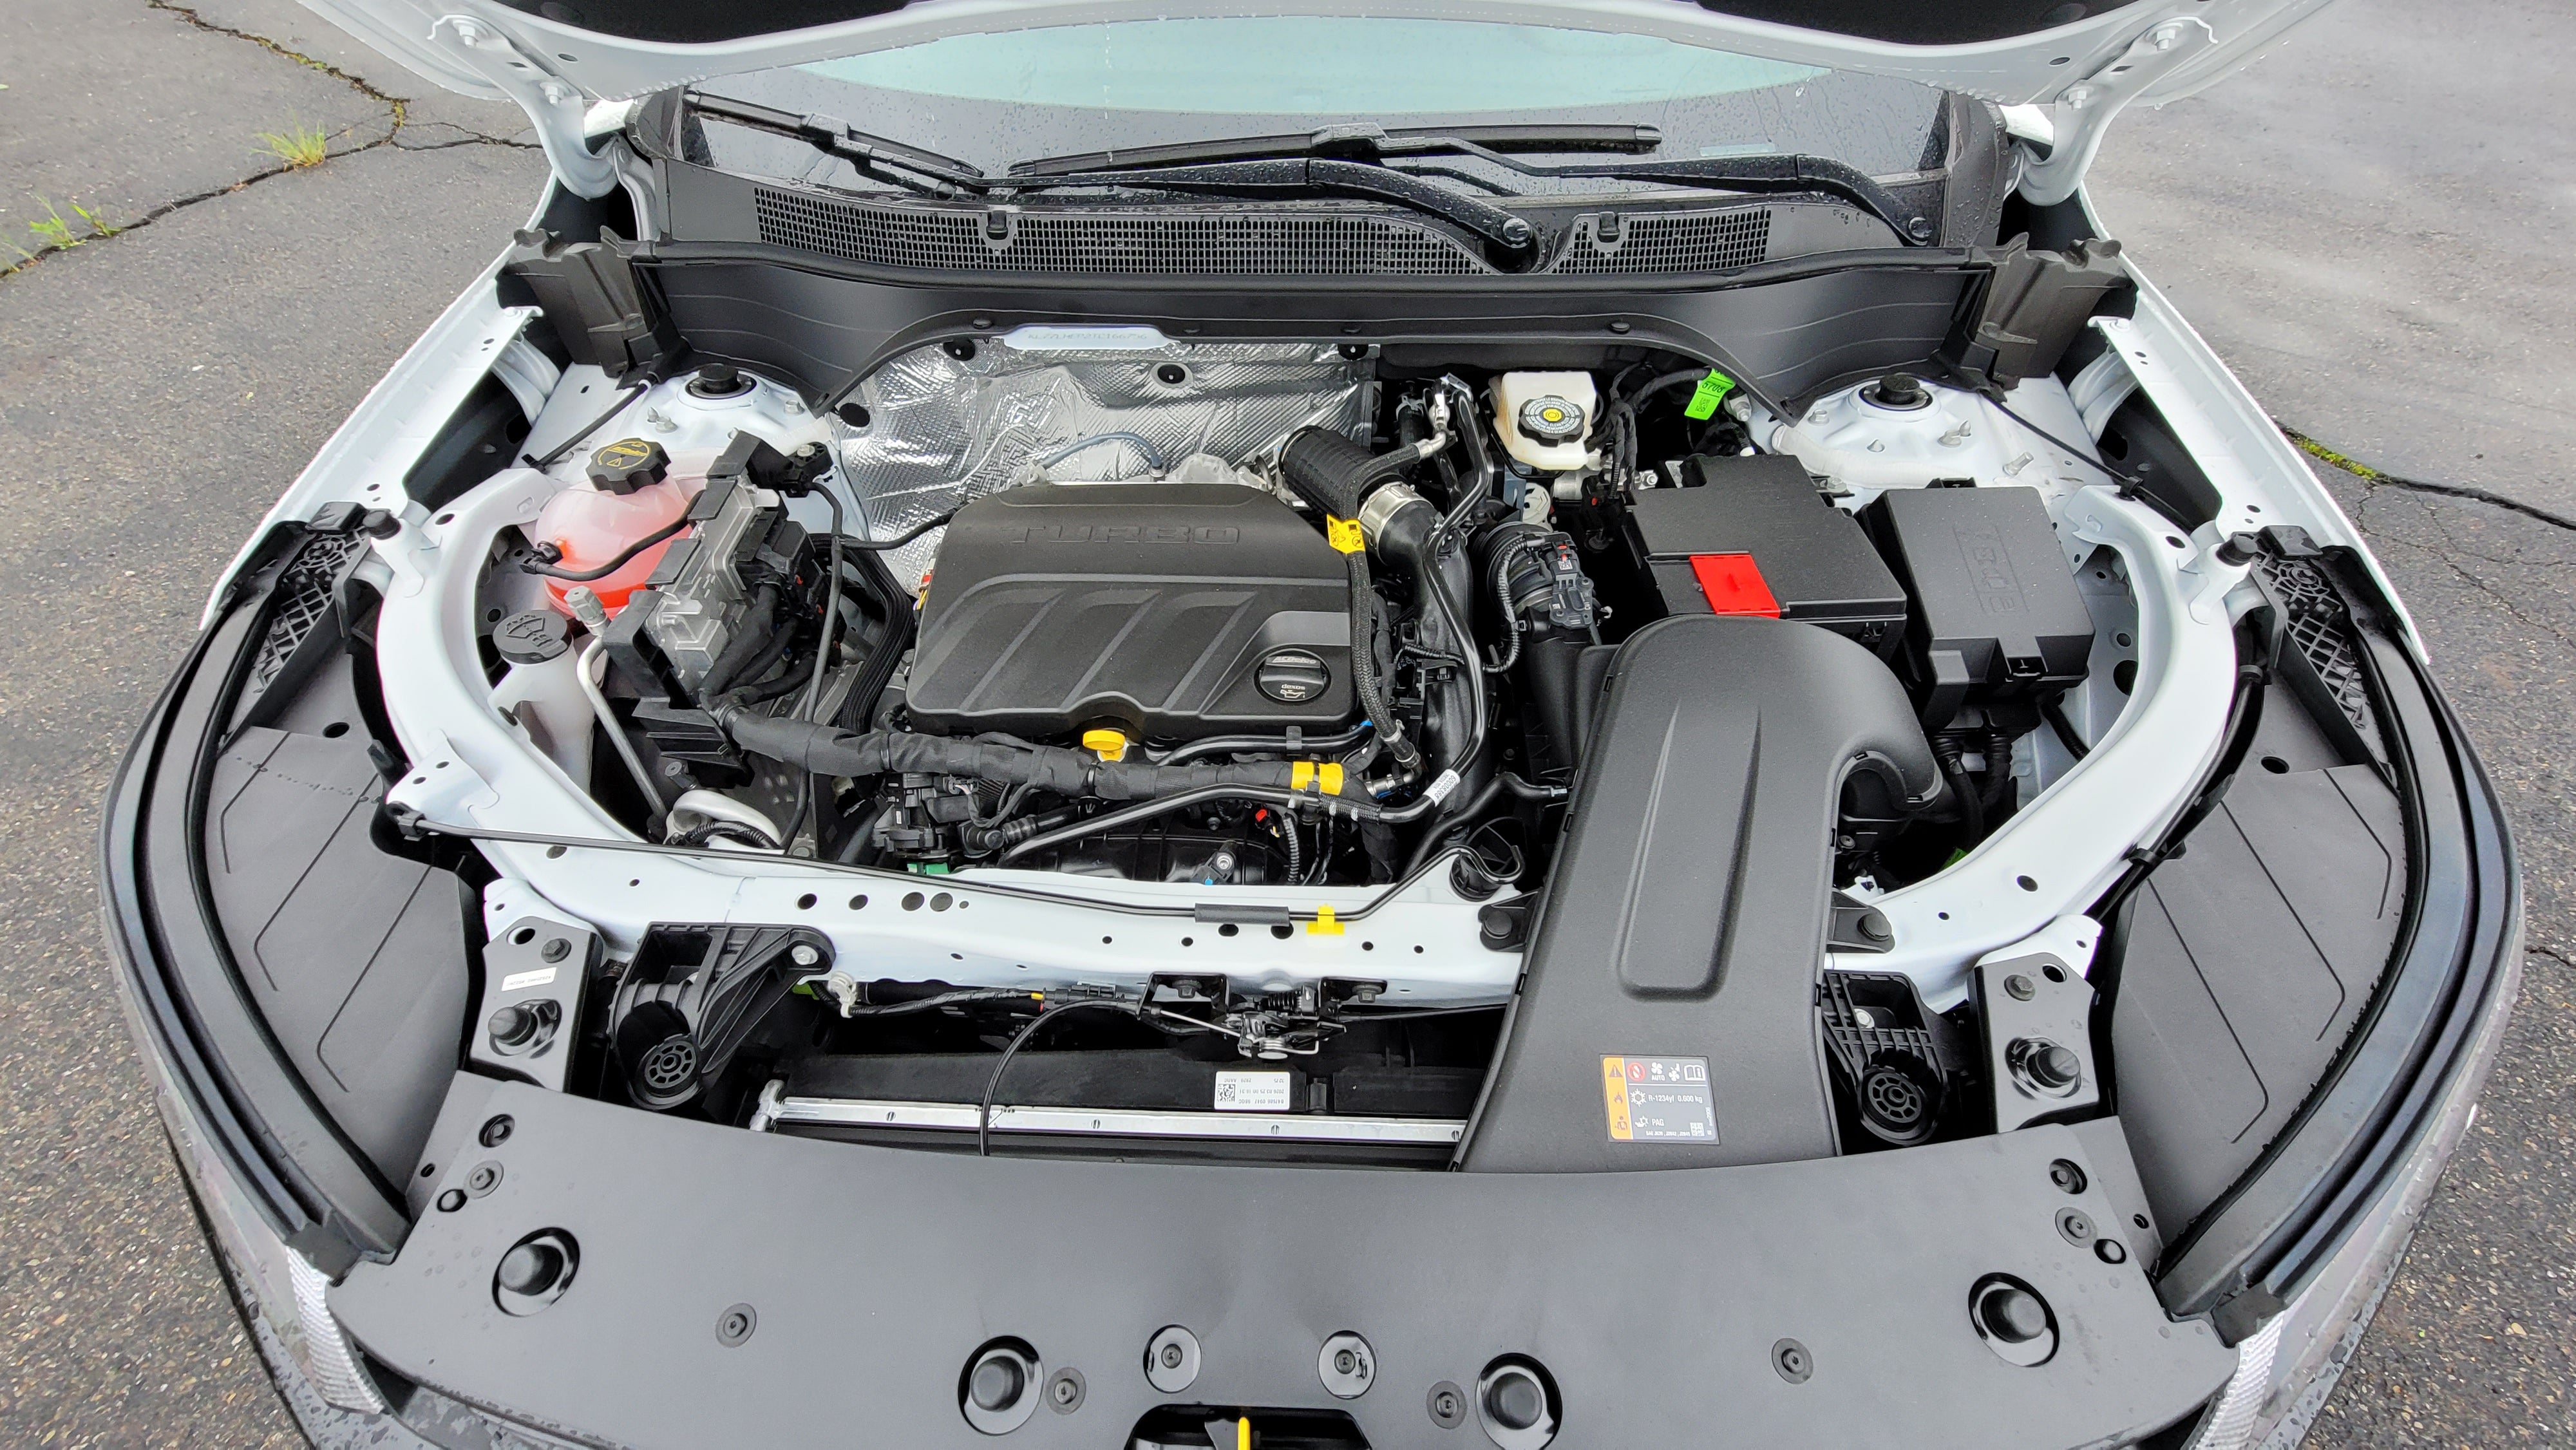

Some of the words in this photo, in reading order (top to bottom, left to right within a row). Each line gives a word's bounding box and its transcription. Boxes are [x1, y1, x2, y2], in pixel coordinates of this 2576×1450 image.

[1702, 381, 1727, 393] 5708
[1000, 525, 1240, 545] TURBO
[1694, 1095, 1703, 1104] kg
